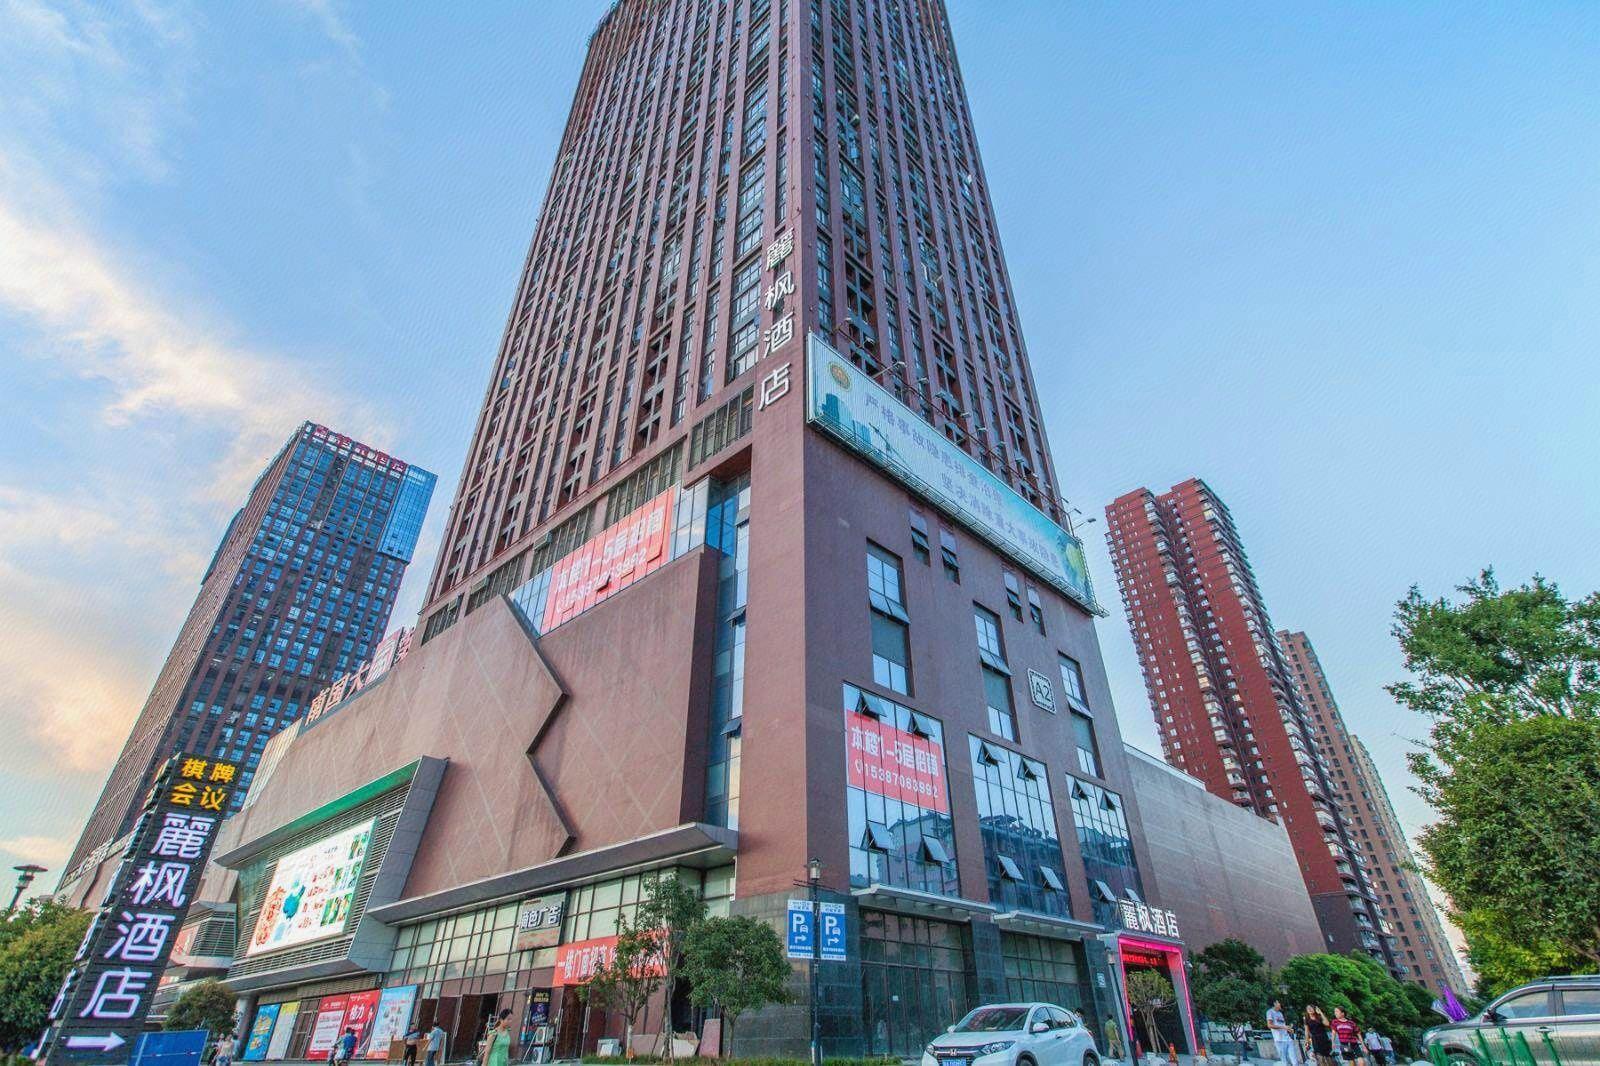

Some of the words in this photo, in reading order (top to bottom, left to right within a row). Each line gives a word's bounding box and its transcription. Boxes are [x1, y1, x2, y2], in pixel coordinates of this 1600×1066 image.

[758, 227, 795, 411] 麗枫酒店
[1035, 681, 1051, 702] A2
[179, 757, 236, 783] 棋牌
[169, 781, 229, 812] 会议
[79, 812, 216, 1020] 麗枫酒店
[792, 913, 805, 933] P
[825, 916, 838, 936] P
[1118, 899, 1180, 939] 麗枫酒店
